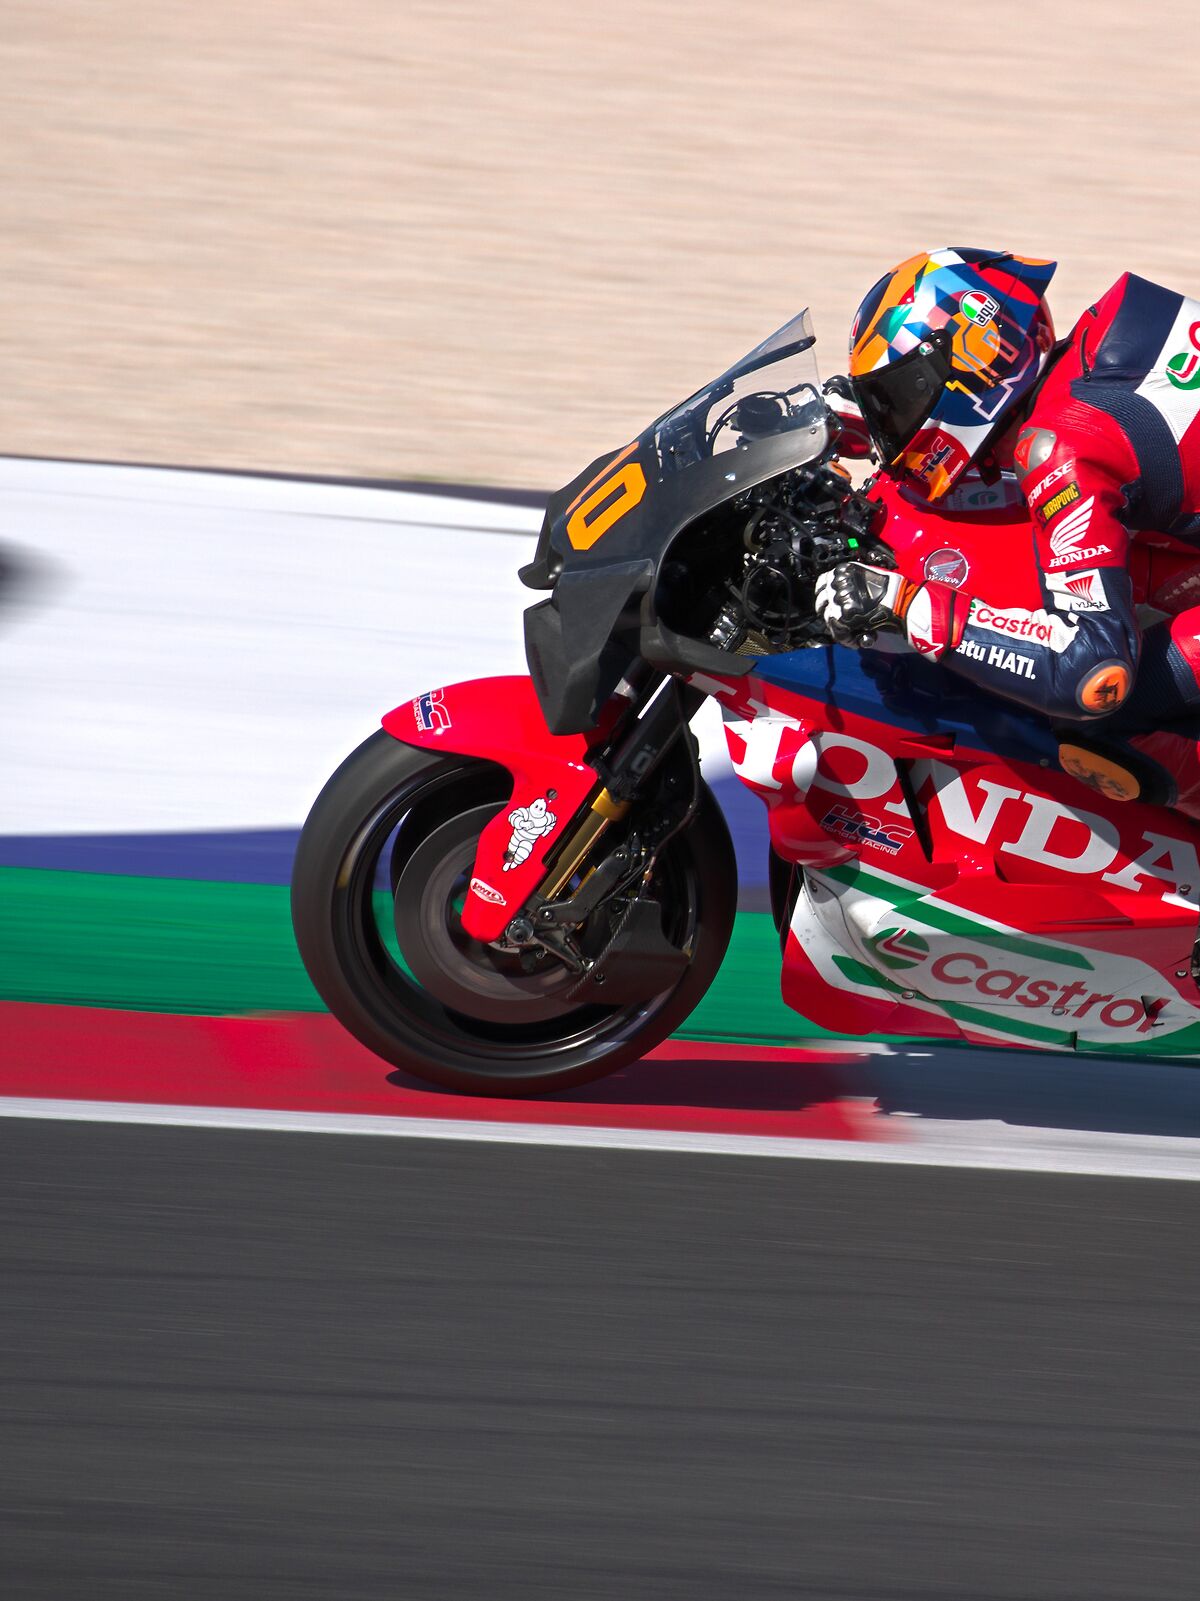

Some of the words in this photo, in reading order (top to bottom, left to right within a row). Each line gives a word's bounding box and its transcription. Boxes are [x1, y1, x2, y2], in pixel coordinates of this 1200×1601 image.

[1027, 459, 1073, 508] DAINESE
[1048, 544, 1112, 567] HONDA
[976, 608, 1053, 641] Castrol
[955, 639, 985, 661] atu
[988, 647, 1036, 680] HATI.
[687, 671, 1200, 912] HONDA
[820, 803, 915, 851] HRC
[857, 837, 899, 856] RACING
[931, 952, 1170, 1034] Castrol
